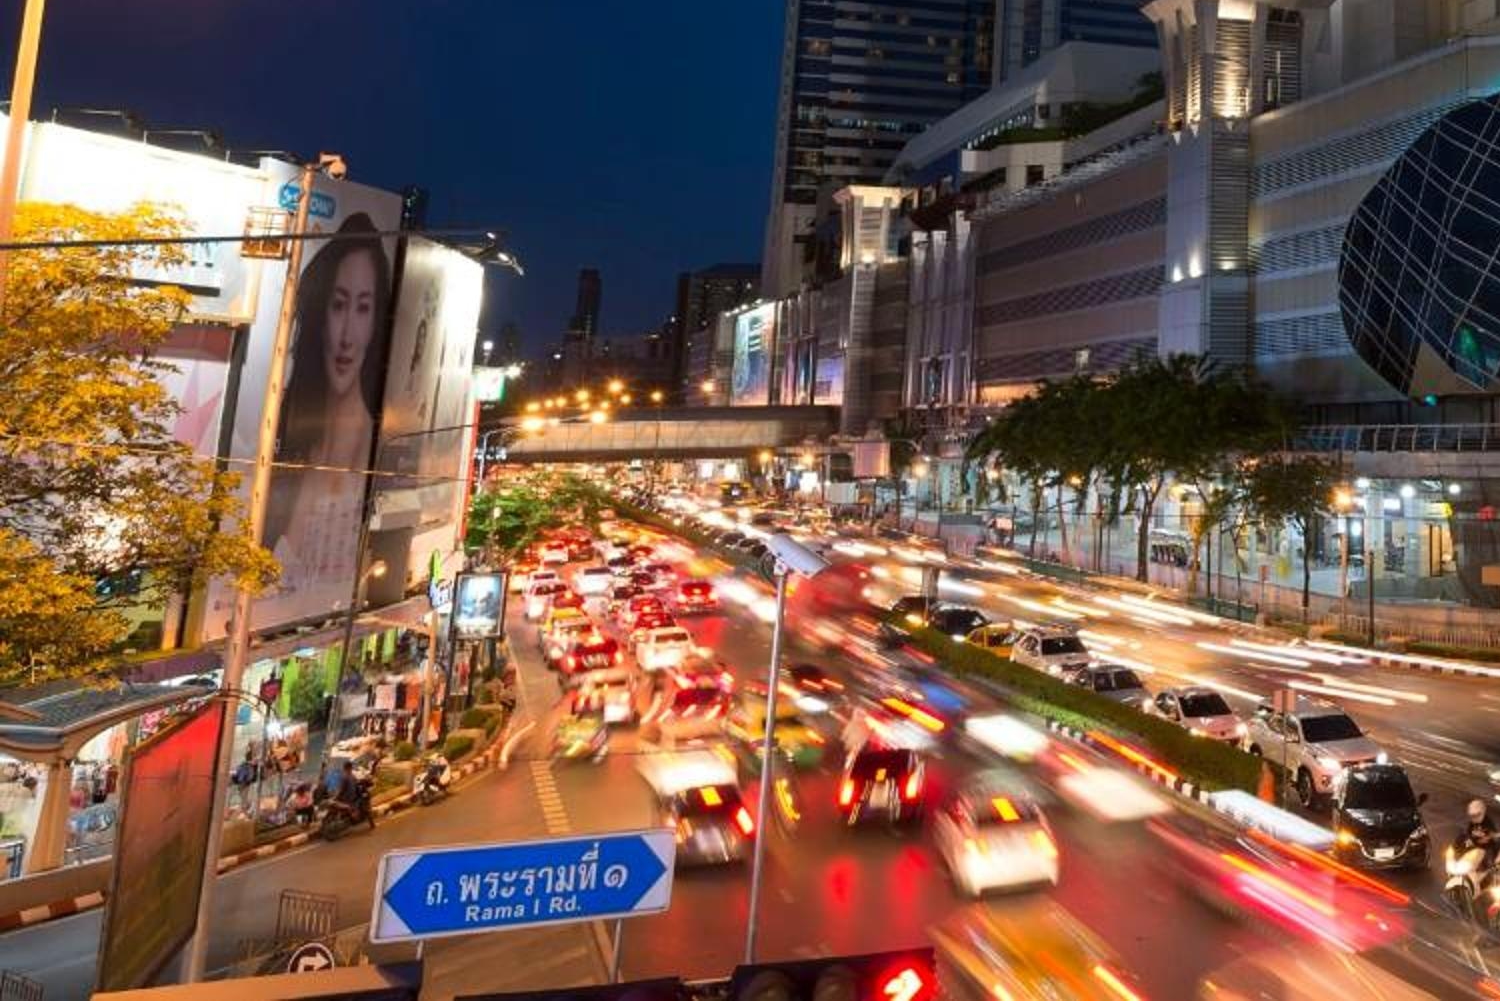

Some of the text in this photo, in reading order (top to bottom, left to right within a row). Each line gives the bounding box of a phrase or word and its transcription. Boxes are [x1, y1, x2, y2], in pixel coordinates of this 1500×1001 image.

[426, 842, 629, 906] ถ. พระรามที่ ๑
[465, 895, 582, 922] Rama I Rd.
